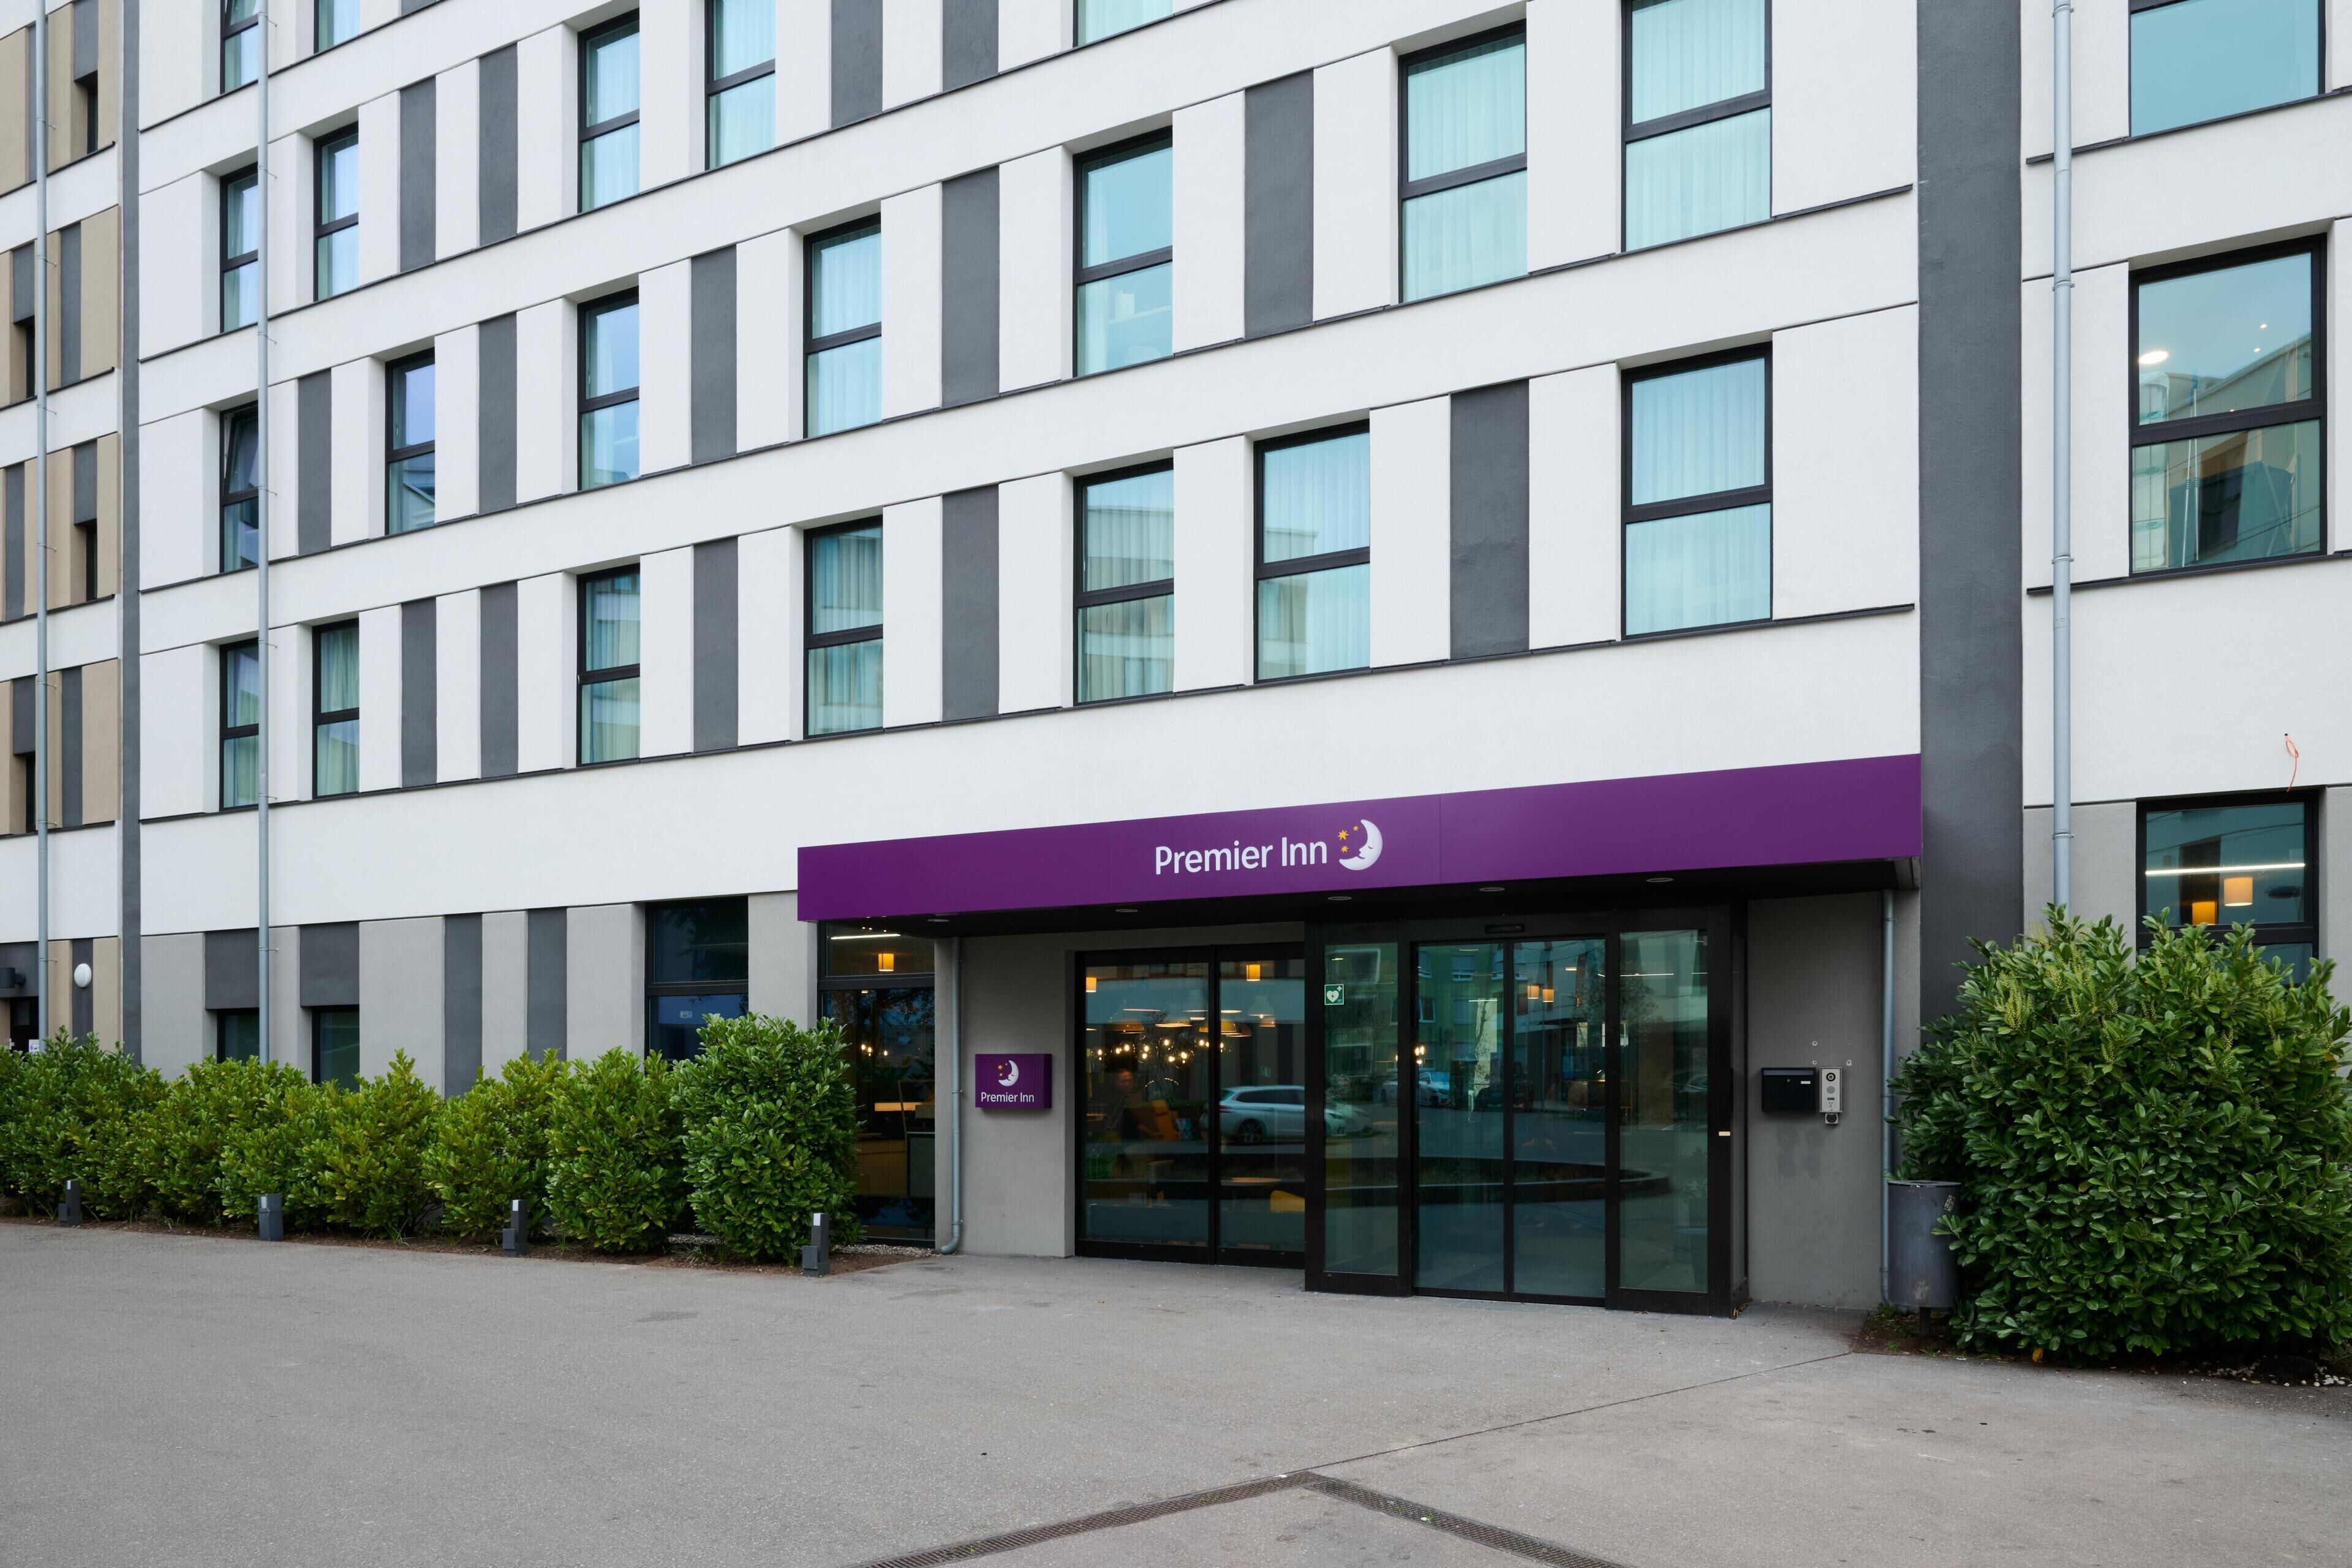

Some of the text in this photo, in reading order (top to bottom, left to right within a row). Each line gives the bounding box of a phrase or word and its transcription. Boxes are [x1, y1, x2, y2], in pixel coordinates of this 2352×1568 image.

[1156, 837, 1327, 875] Premier Inn
[981, 1092, 1035, 1102] Premier Inn
